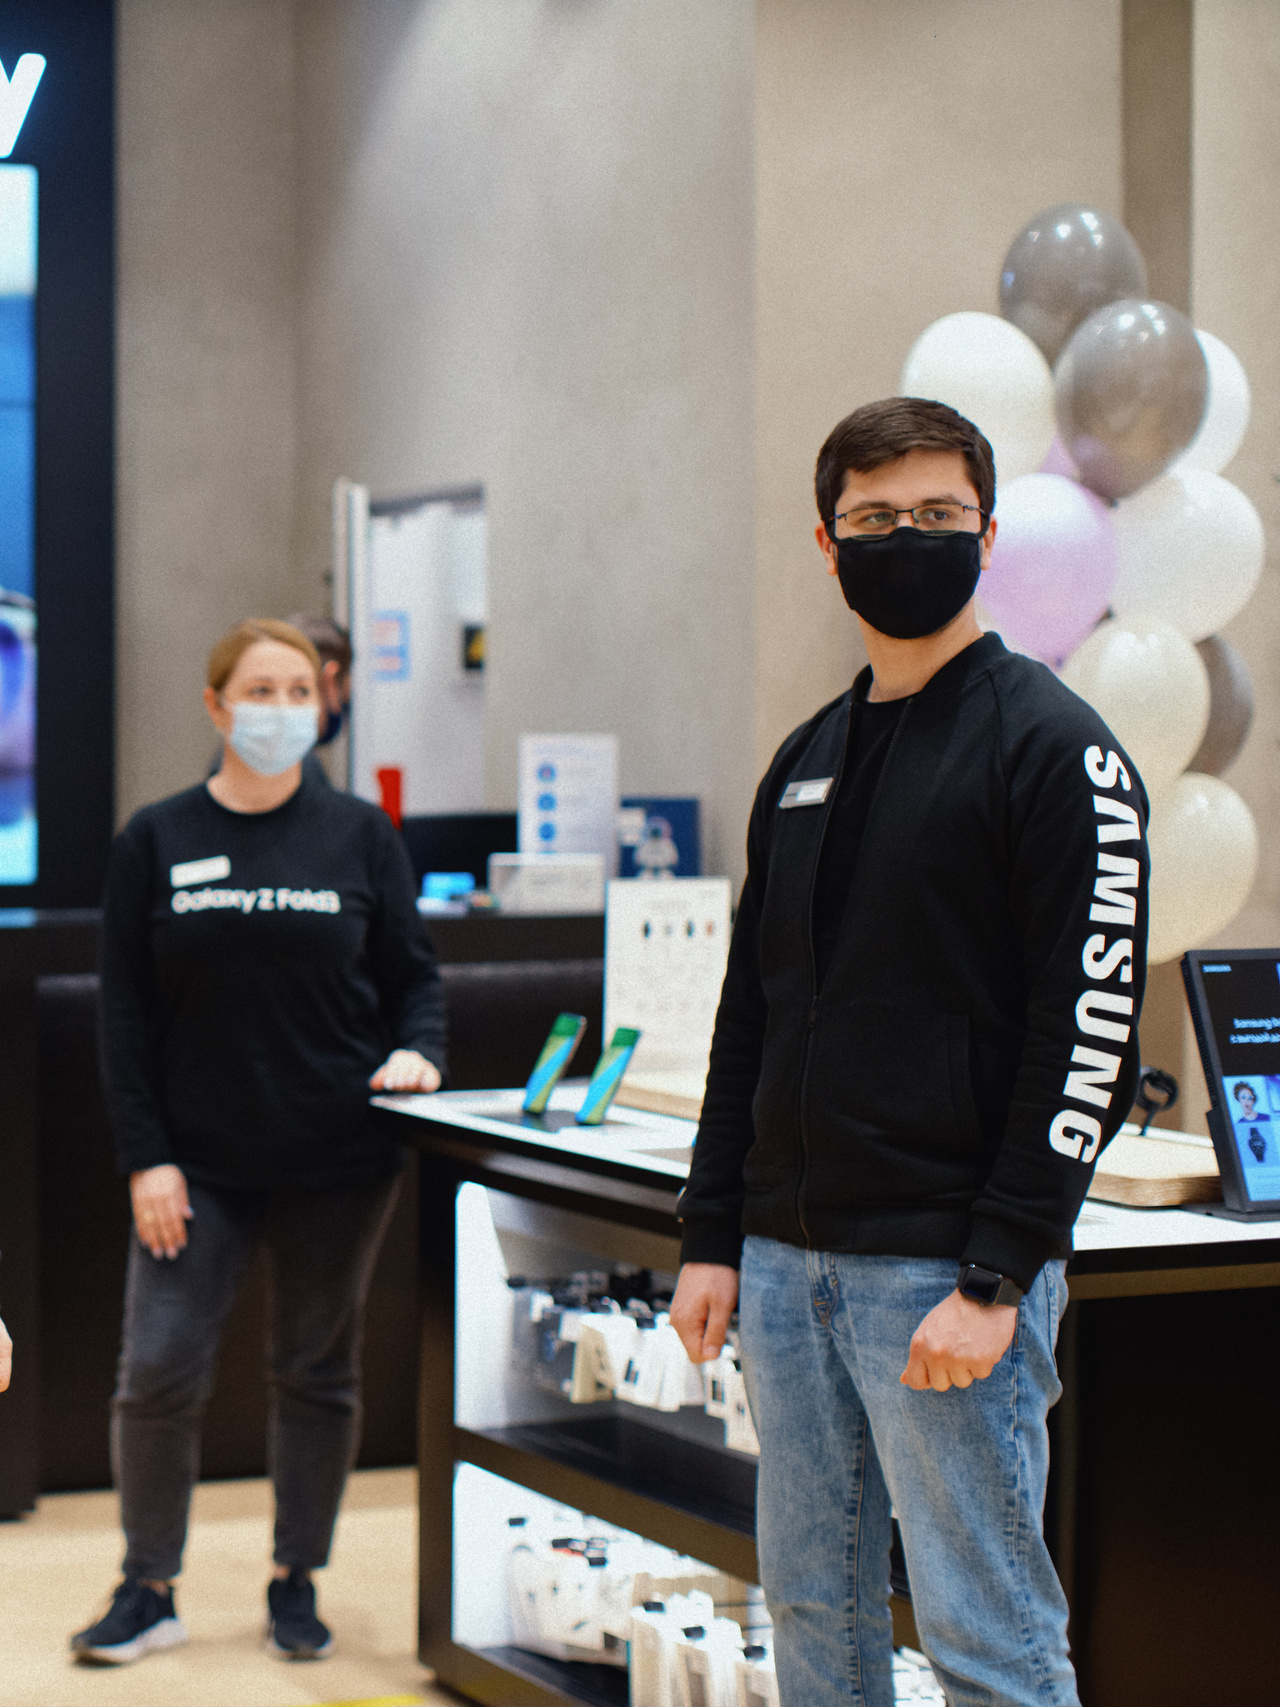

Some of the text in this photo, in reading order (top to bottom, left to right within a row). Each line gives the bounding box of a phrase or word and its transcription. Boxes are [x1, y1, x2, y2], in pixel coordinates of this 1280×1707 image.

[171, 887, 341, 914] Galaxy Z Fold3
[1048, 745, 1141, 1163] SAMSUNG
